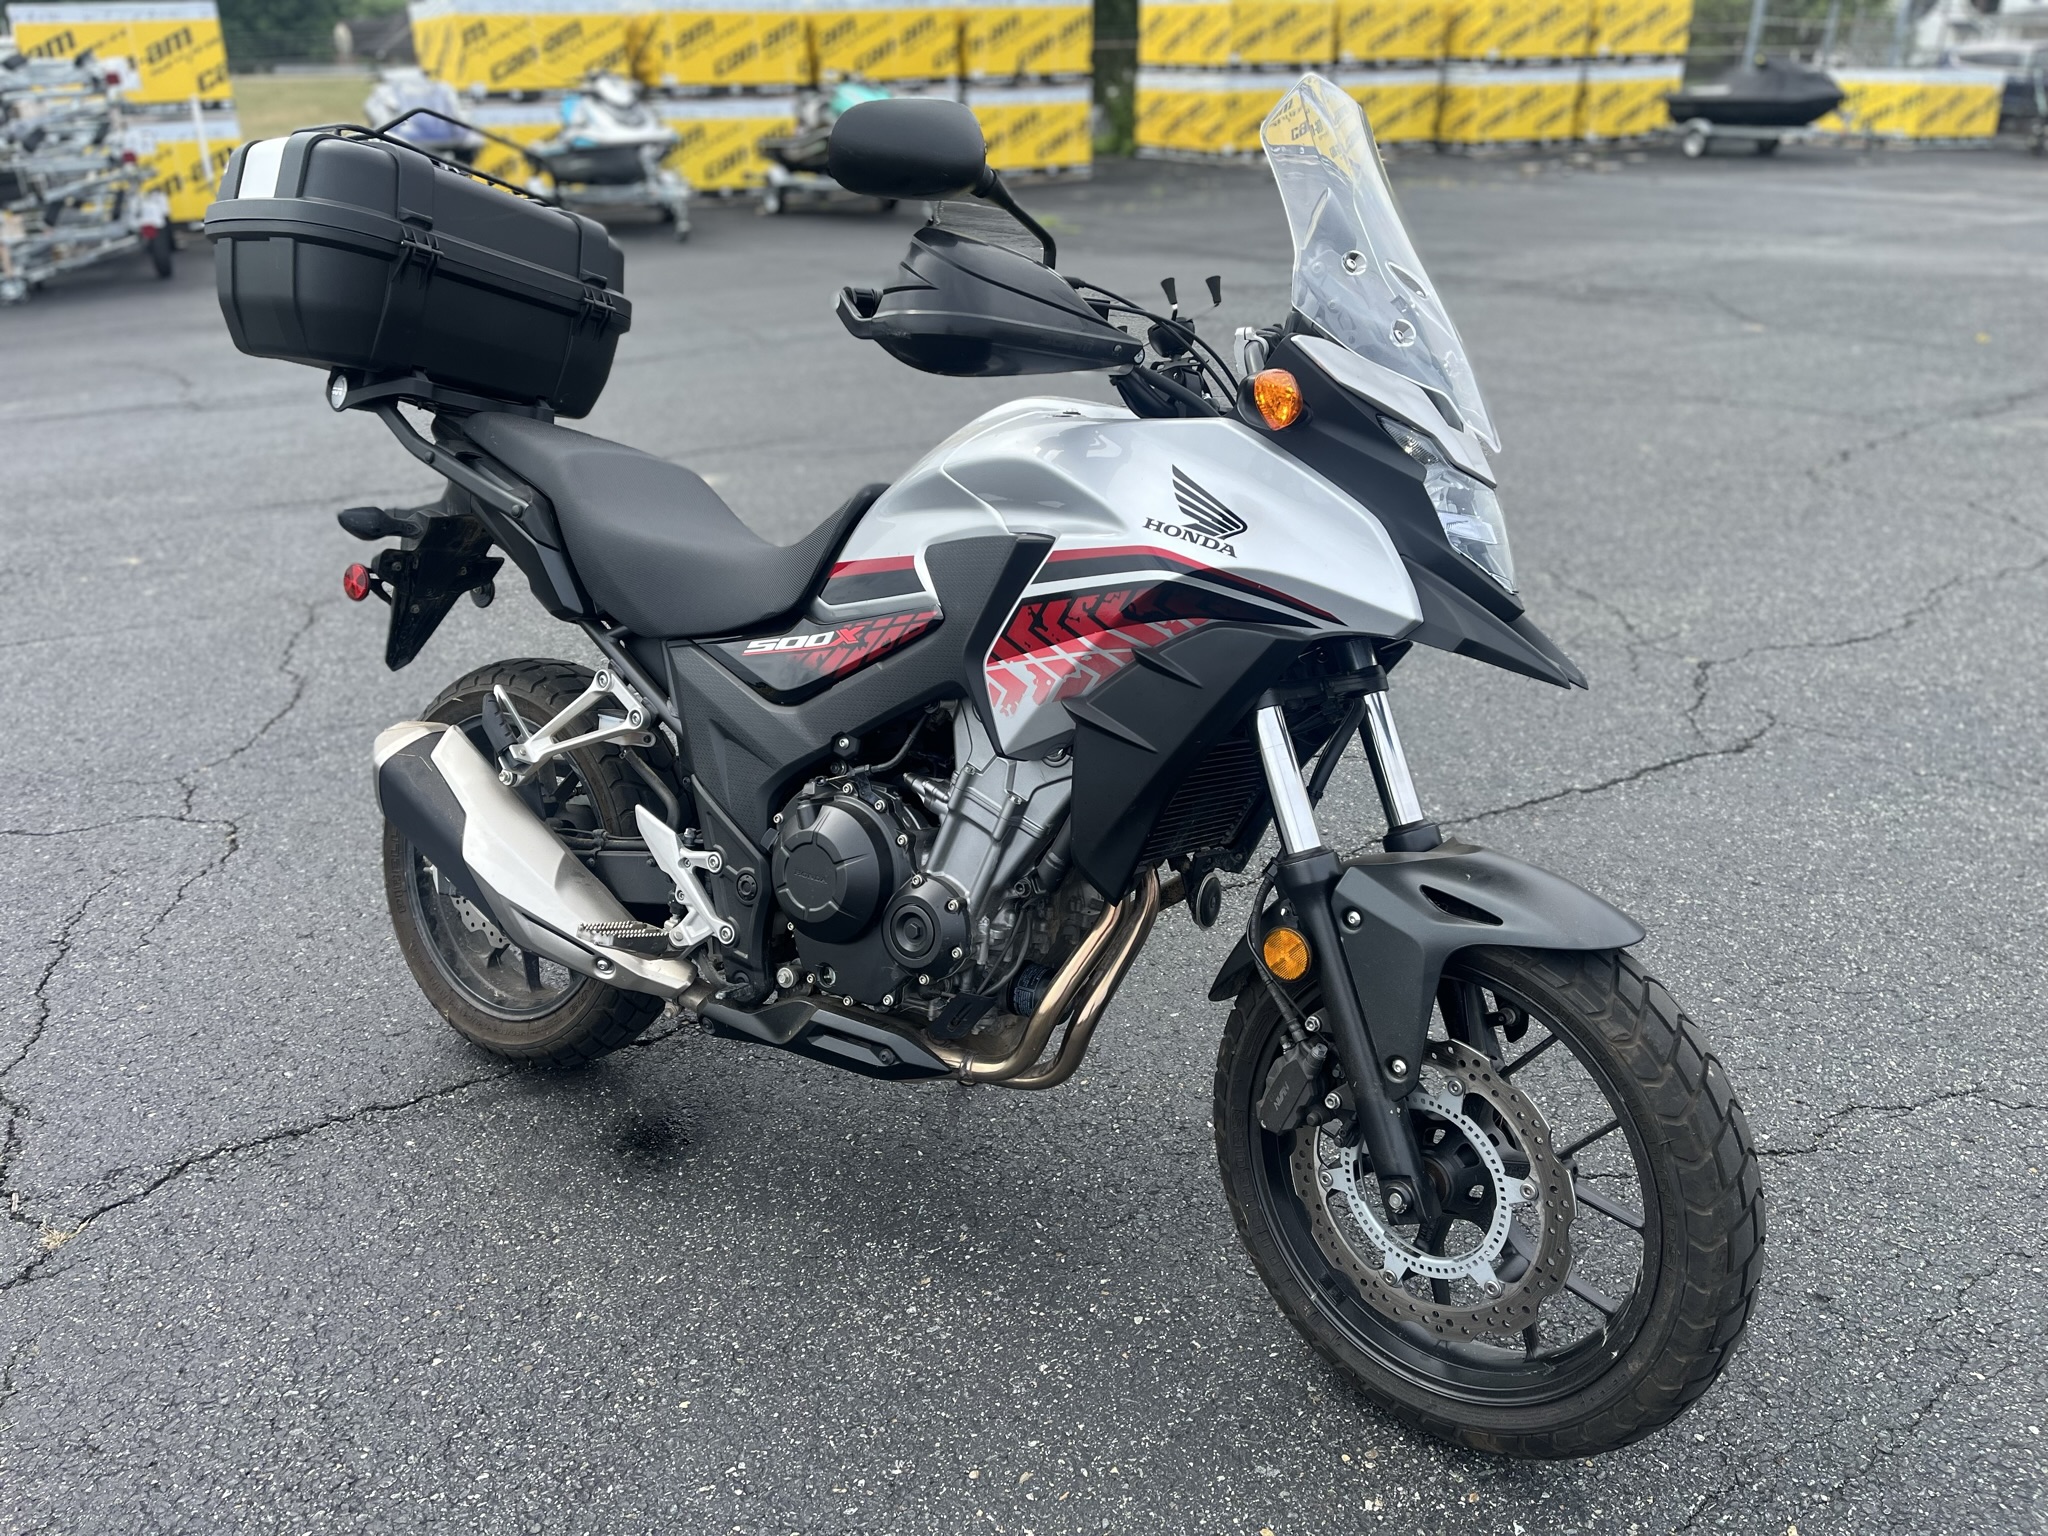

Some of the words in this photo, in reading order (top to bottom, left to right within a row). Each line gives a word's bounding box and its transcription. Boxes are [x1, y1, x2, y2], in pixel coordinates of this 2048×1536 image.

[1142, 517, 1238, 558] HONDA
[742, 625, 866, 655] 500X
[390, 826, 407, 914] PIRELL
